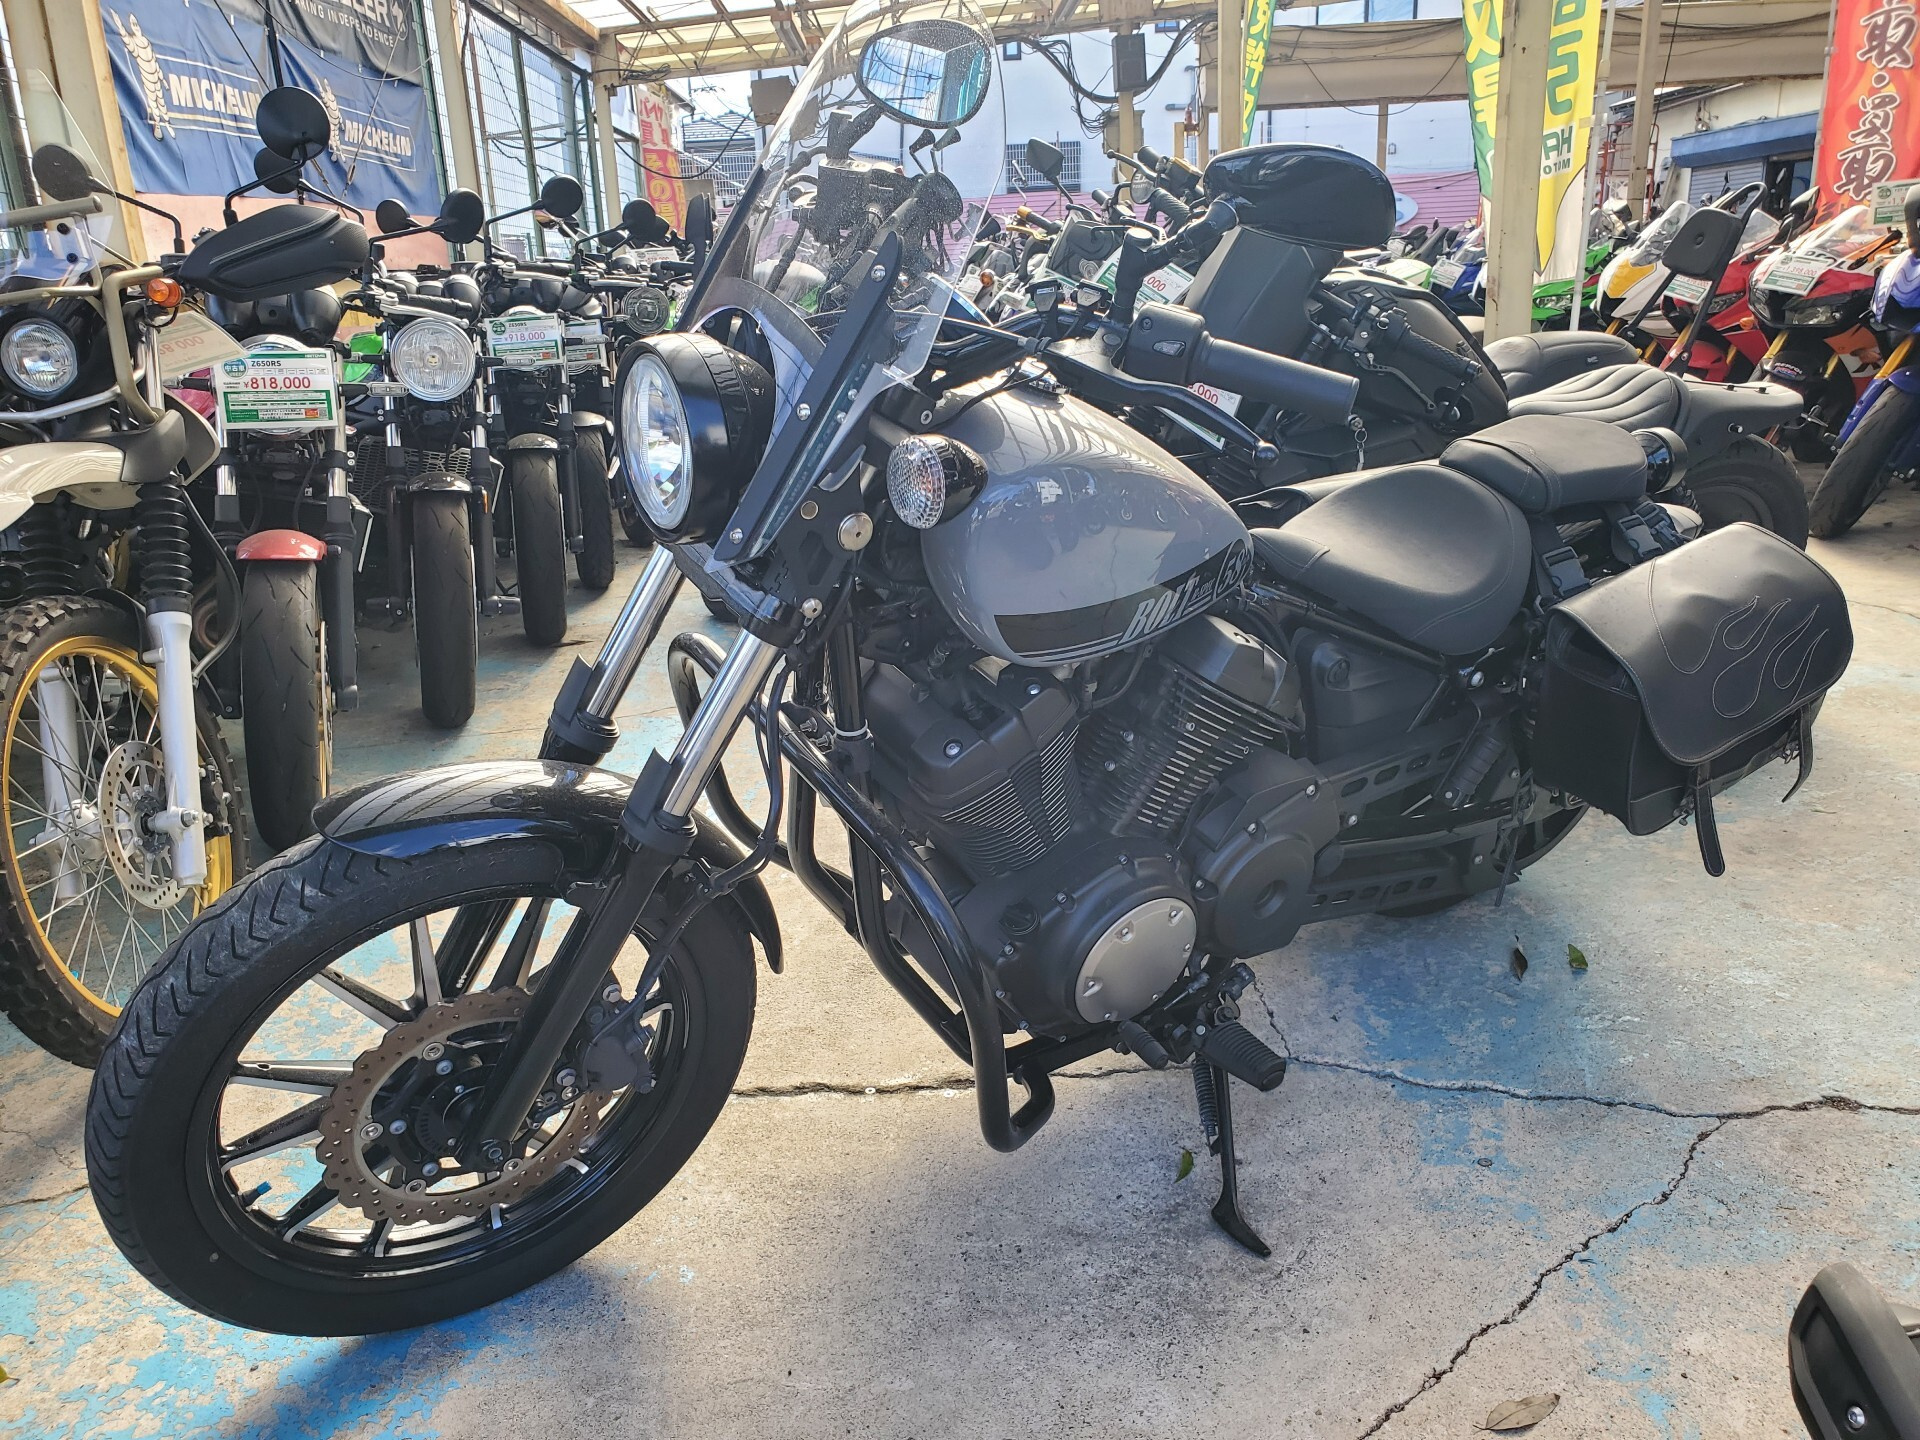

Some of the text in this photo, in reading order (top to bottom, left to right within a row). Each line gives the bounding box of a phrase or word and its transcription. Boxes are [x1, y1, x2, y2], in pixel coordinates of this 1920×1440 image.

[327, 8, 394, 47] INDEPENDENCE
[344, 119, 412, 157] MICHELIN
[504, 331, 546, 342] ¥918,000
[243, 376, 311, 391] ¥818,000
[1119, 571, 1201, 644] BOLT
